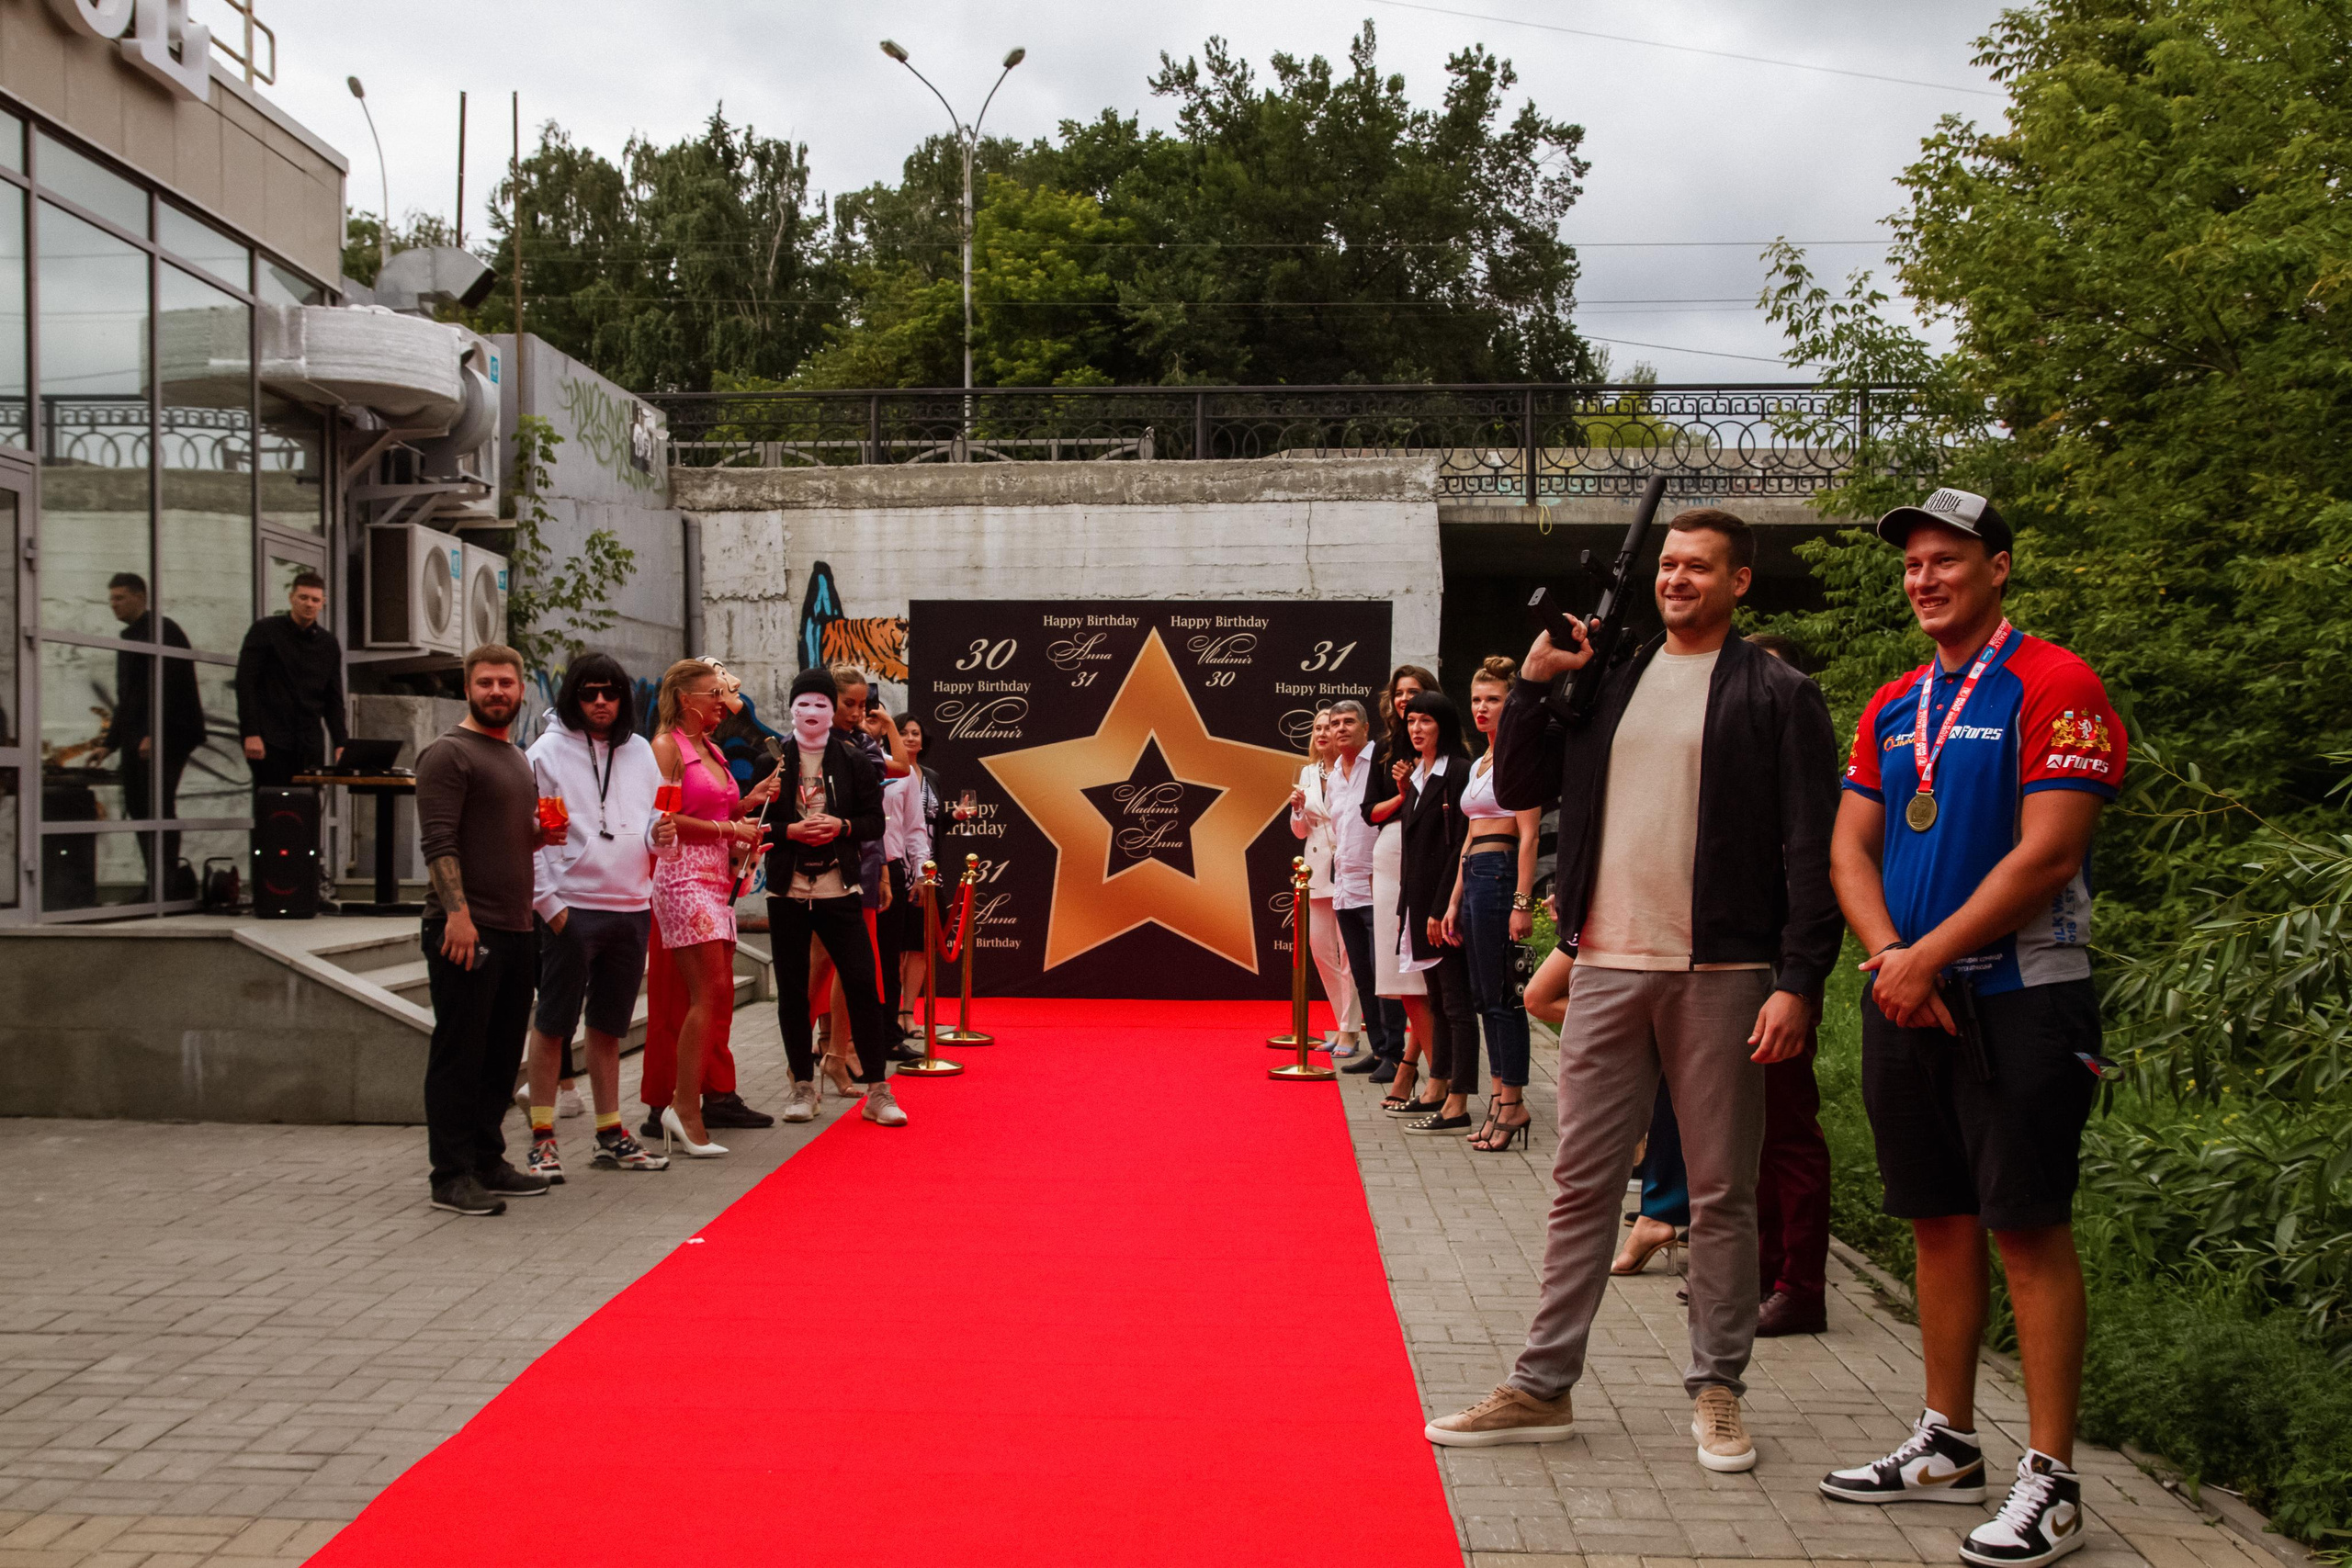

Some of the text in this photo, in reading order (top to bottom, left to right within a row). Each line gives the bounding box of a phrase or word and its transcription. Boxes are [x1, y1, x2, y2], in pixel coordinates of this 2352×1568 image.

[1044, 615, 1139, 628] Happy Birthday
[1170, 615, 1269, 630] Happy Birthday
[956, 638, 1017, 671] 30
[1046, 632, 1113, 671] Anna
[1187, 633, 1257, 665] Vladimir
[1301, 641, 1357, 671] 31
[933, 680, 1031, 694] Happy Birthday
[1071, 671, 1098, 687] 31
[1205, 671, 1236, 687] 30
[1275, 682, 1372, 696] Happy Birthday
[934, 696, 1028, 740] Vladimir
[1113, 782, 1183, 815] Vladimir
[944, 801, 999, 818] Hpy
[946, 820, 1007, 838] rthday
[1116, 819, 1182, 858] Anna
[976, 860, 1010, 883] 31
[976, 938, 1021, 949] Birthday
[1274, 940, 1294, 952] Hap
